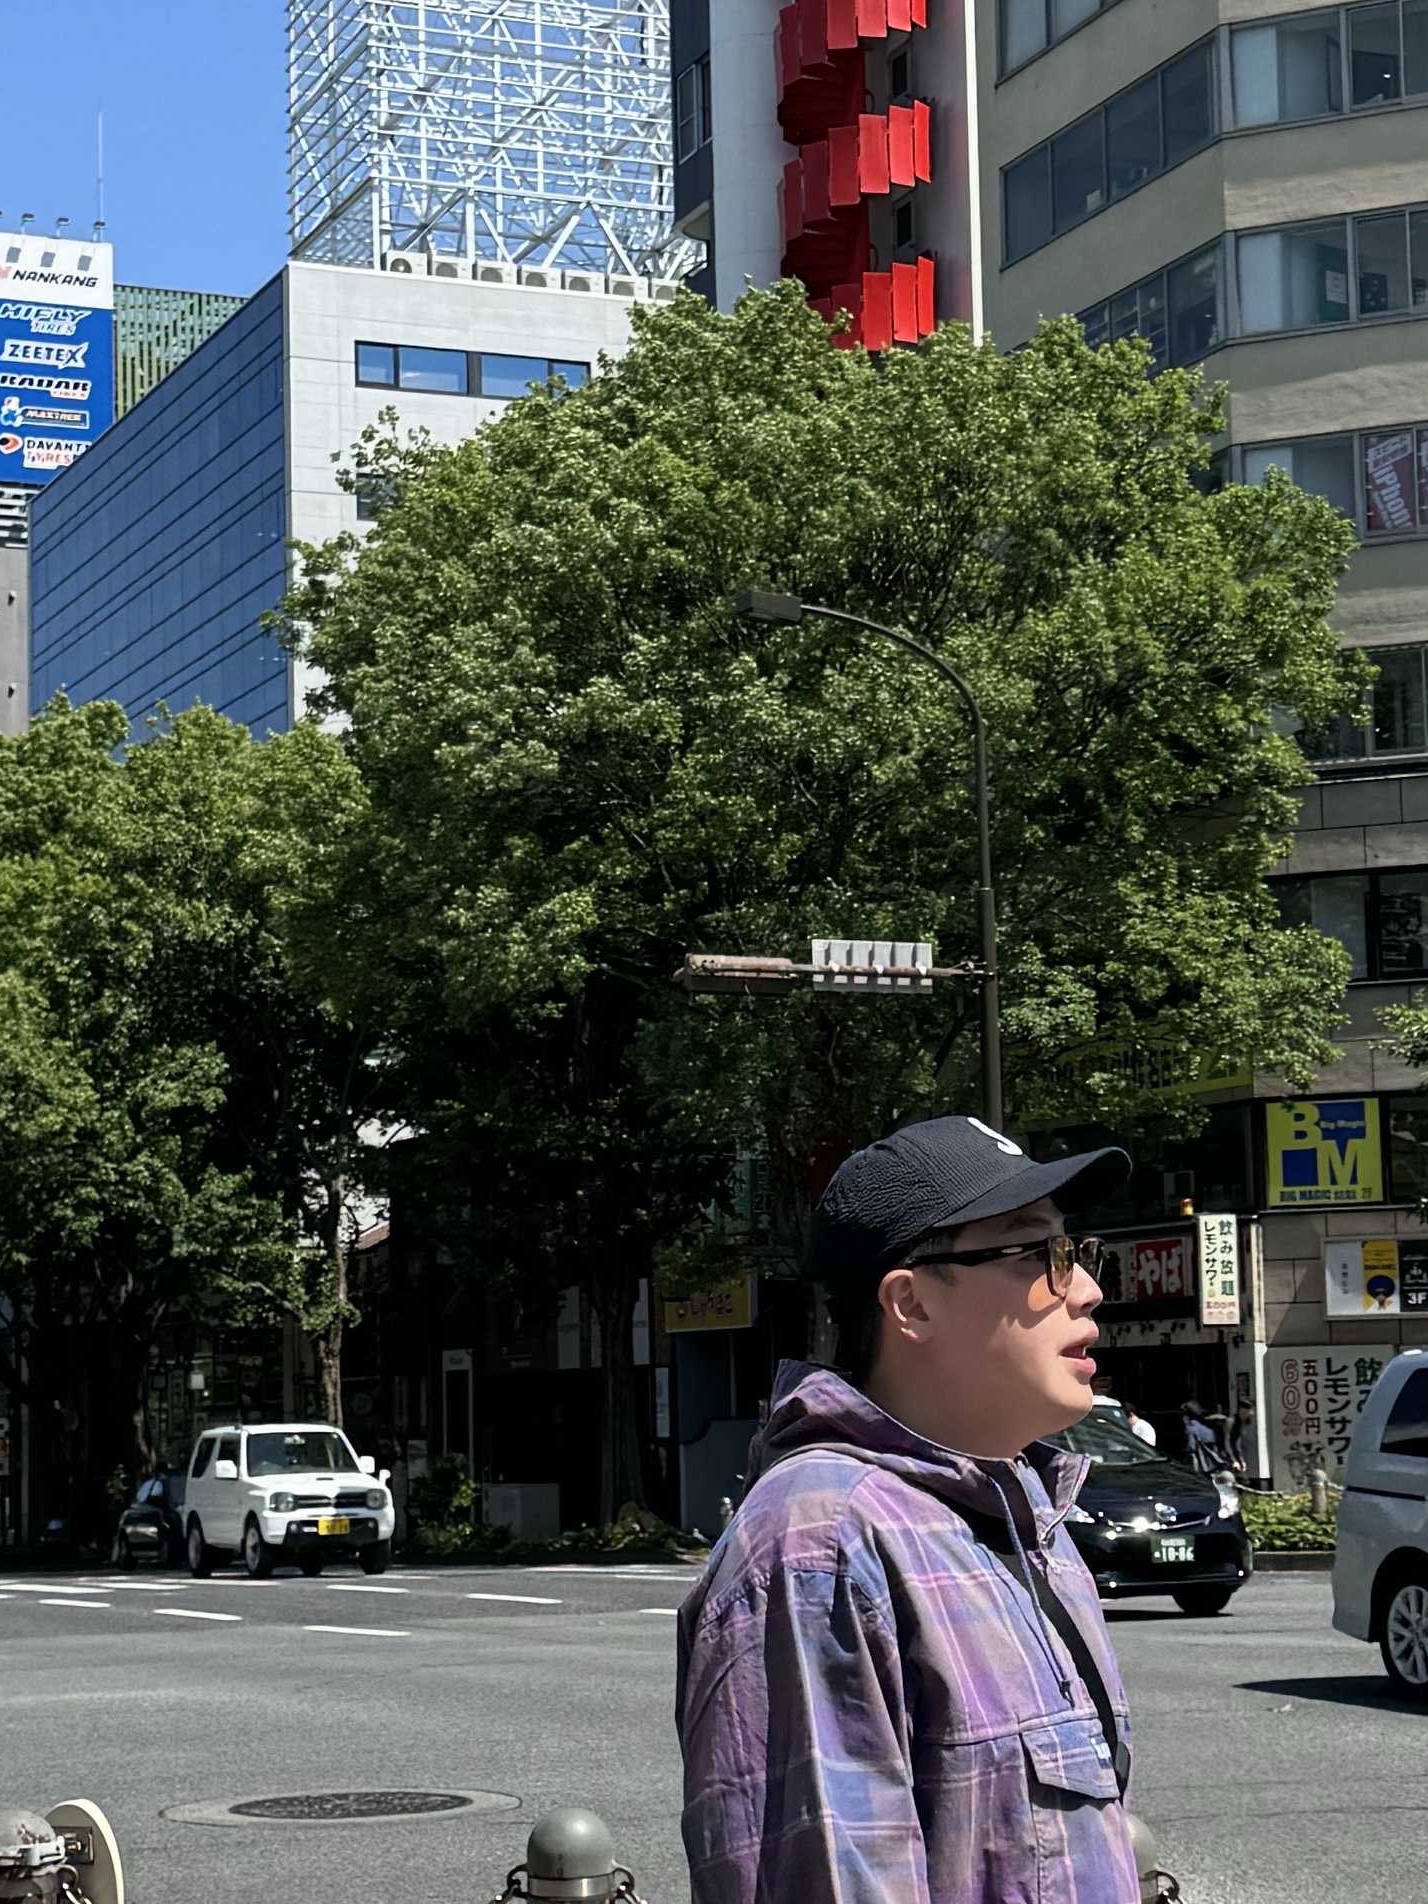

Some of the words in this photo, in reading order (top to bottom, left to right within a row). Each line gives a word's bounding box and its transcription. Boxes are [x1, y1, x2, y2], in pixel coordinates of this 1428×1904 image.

[12, 270, 99, 288] NANKANG
[8, 343, 84, 365] ZEETEX
[0, 375, 89, 392] RADAR
[1407, 1292, 1427, 1305] 3F
